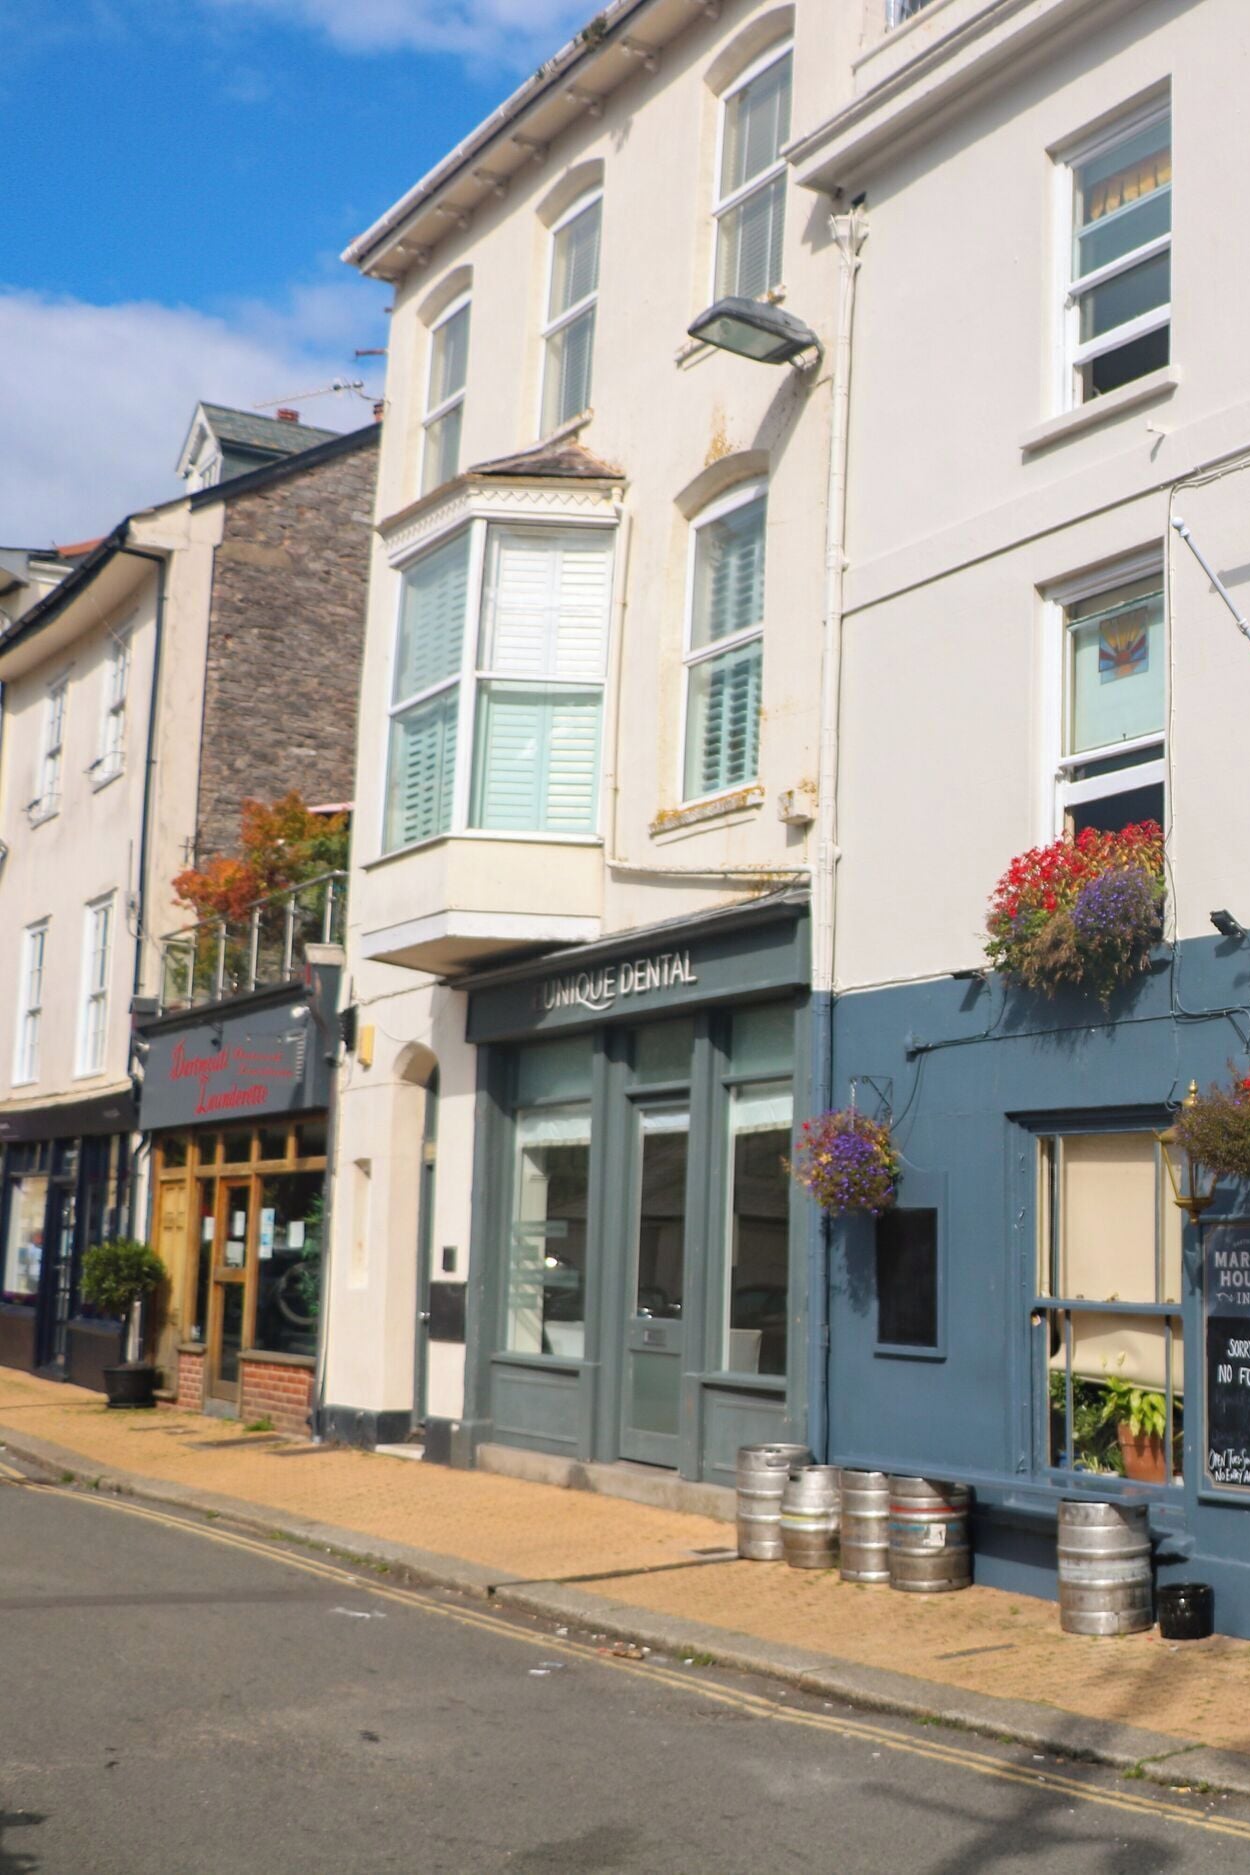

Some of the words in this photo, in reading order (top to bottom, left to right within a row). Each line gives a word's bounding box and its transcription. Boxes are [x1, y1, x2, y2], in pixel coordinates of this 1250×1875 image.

[544, 966, 617, 1011] UNIQUE
[620, 950, 698, 994] DENTAL
[1217, 1365, 1233, 1383] NO
